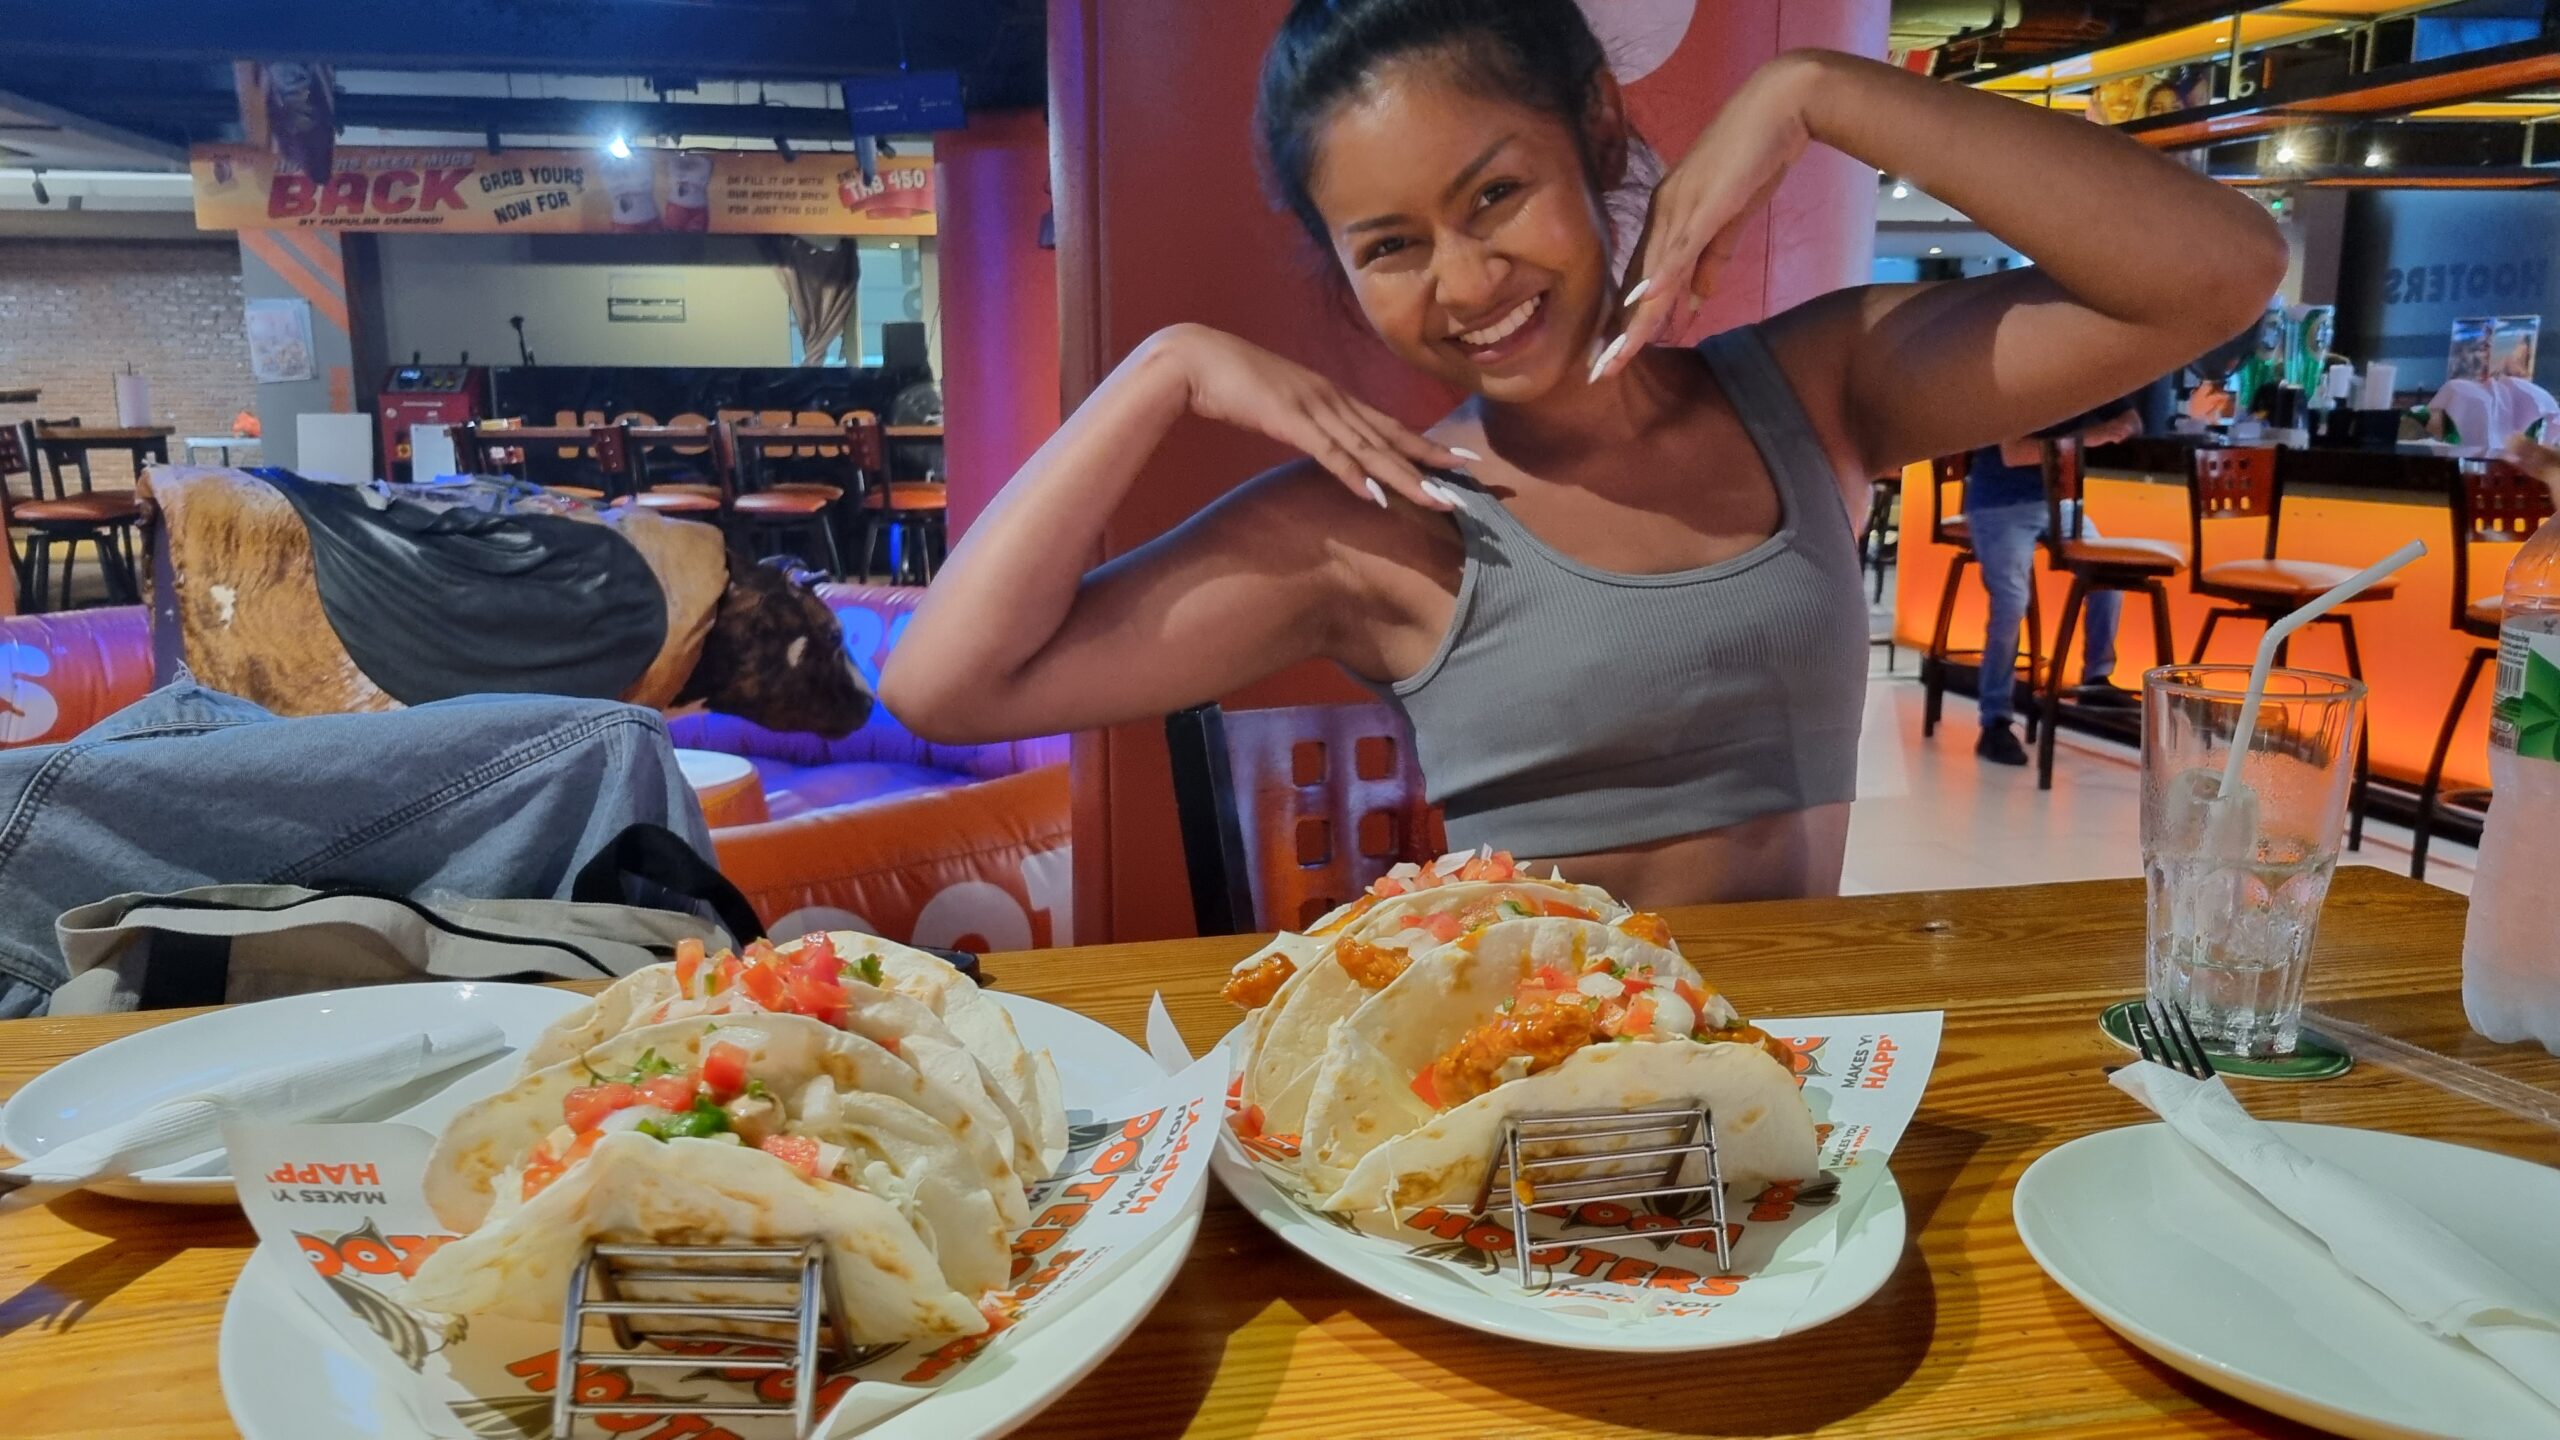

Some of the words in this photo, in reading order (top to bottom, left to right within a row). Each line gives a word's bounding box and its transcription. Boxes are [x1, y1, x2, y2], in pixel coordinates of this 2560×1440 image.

[268, 167, 474, 219] BACK
[480, 167, 525, 193] GRAB
[529, 166, 584, 184] YOURS
[887, 168, 925, 191] 450
[320, 216, 380, 227] POPULAR
[493, 197, 533, 225] NOW
[536, 191, 571, 212] FOR
[1841, 1048, 1870, 1088] MAKES
[1108, 1153, 1166, 1215] MAKES
[1160, 1104, 1187, 1150] YOU
[1126, 1096, 1204, 1214] HAPPY!
[264, 1162, 380, 1186] HAPP
[299, 1189, 387, 1205] MAKES
[1404, 1206, 1750, 1297] HOOTERS
